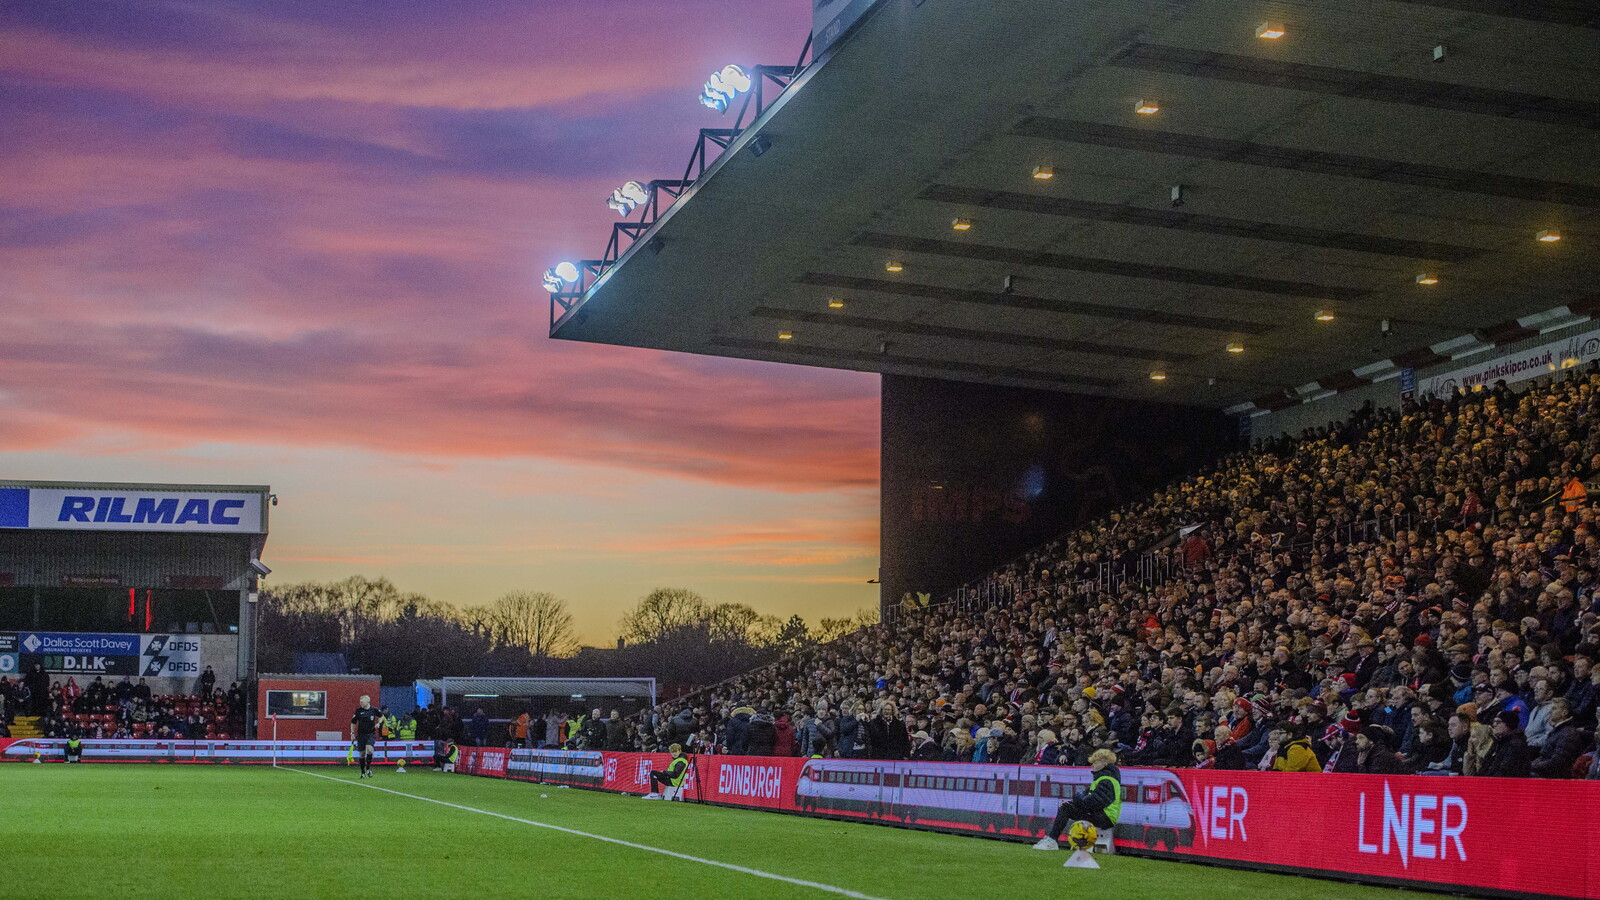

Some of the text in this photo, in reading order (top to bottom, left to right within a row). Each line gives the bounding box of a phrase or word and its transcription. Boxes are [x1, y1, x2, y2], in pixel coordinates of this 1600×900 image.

[1462, 350, 1553, 387] www.pinkskipco.co.uk
[57, 496, 245, 525] RILMAC
[43, 637, 132, 651] Dallas Scott Davey
[169, 641, 198, 652] DFDS
[63, 655, 107, 670] D.I.K
[168, 661, 198, 672] DFDS
[718, 764, 782, 799] EDINBURGH
[1358, 778, 1468, 870] LNER
